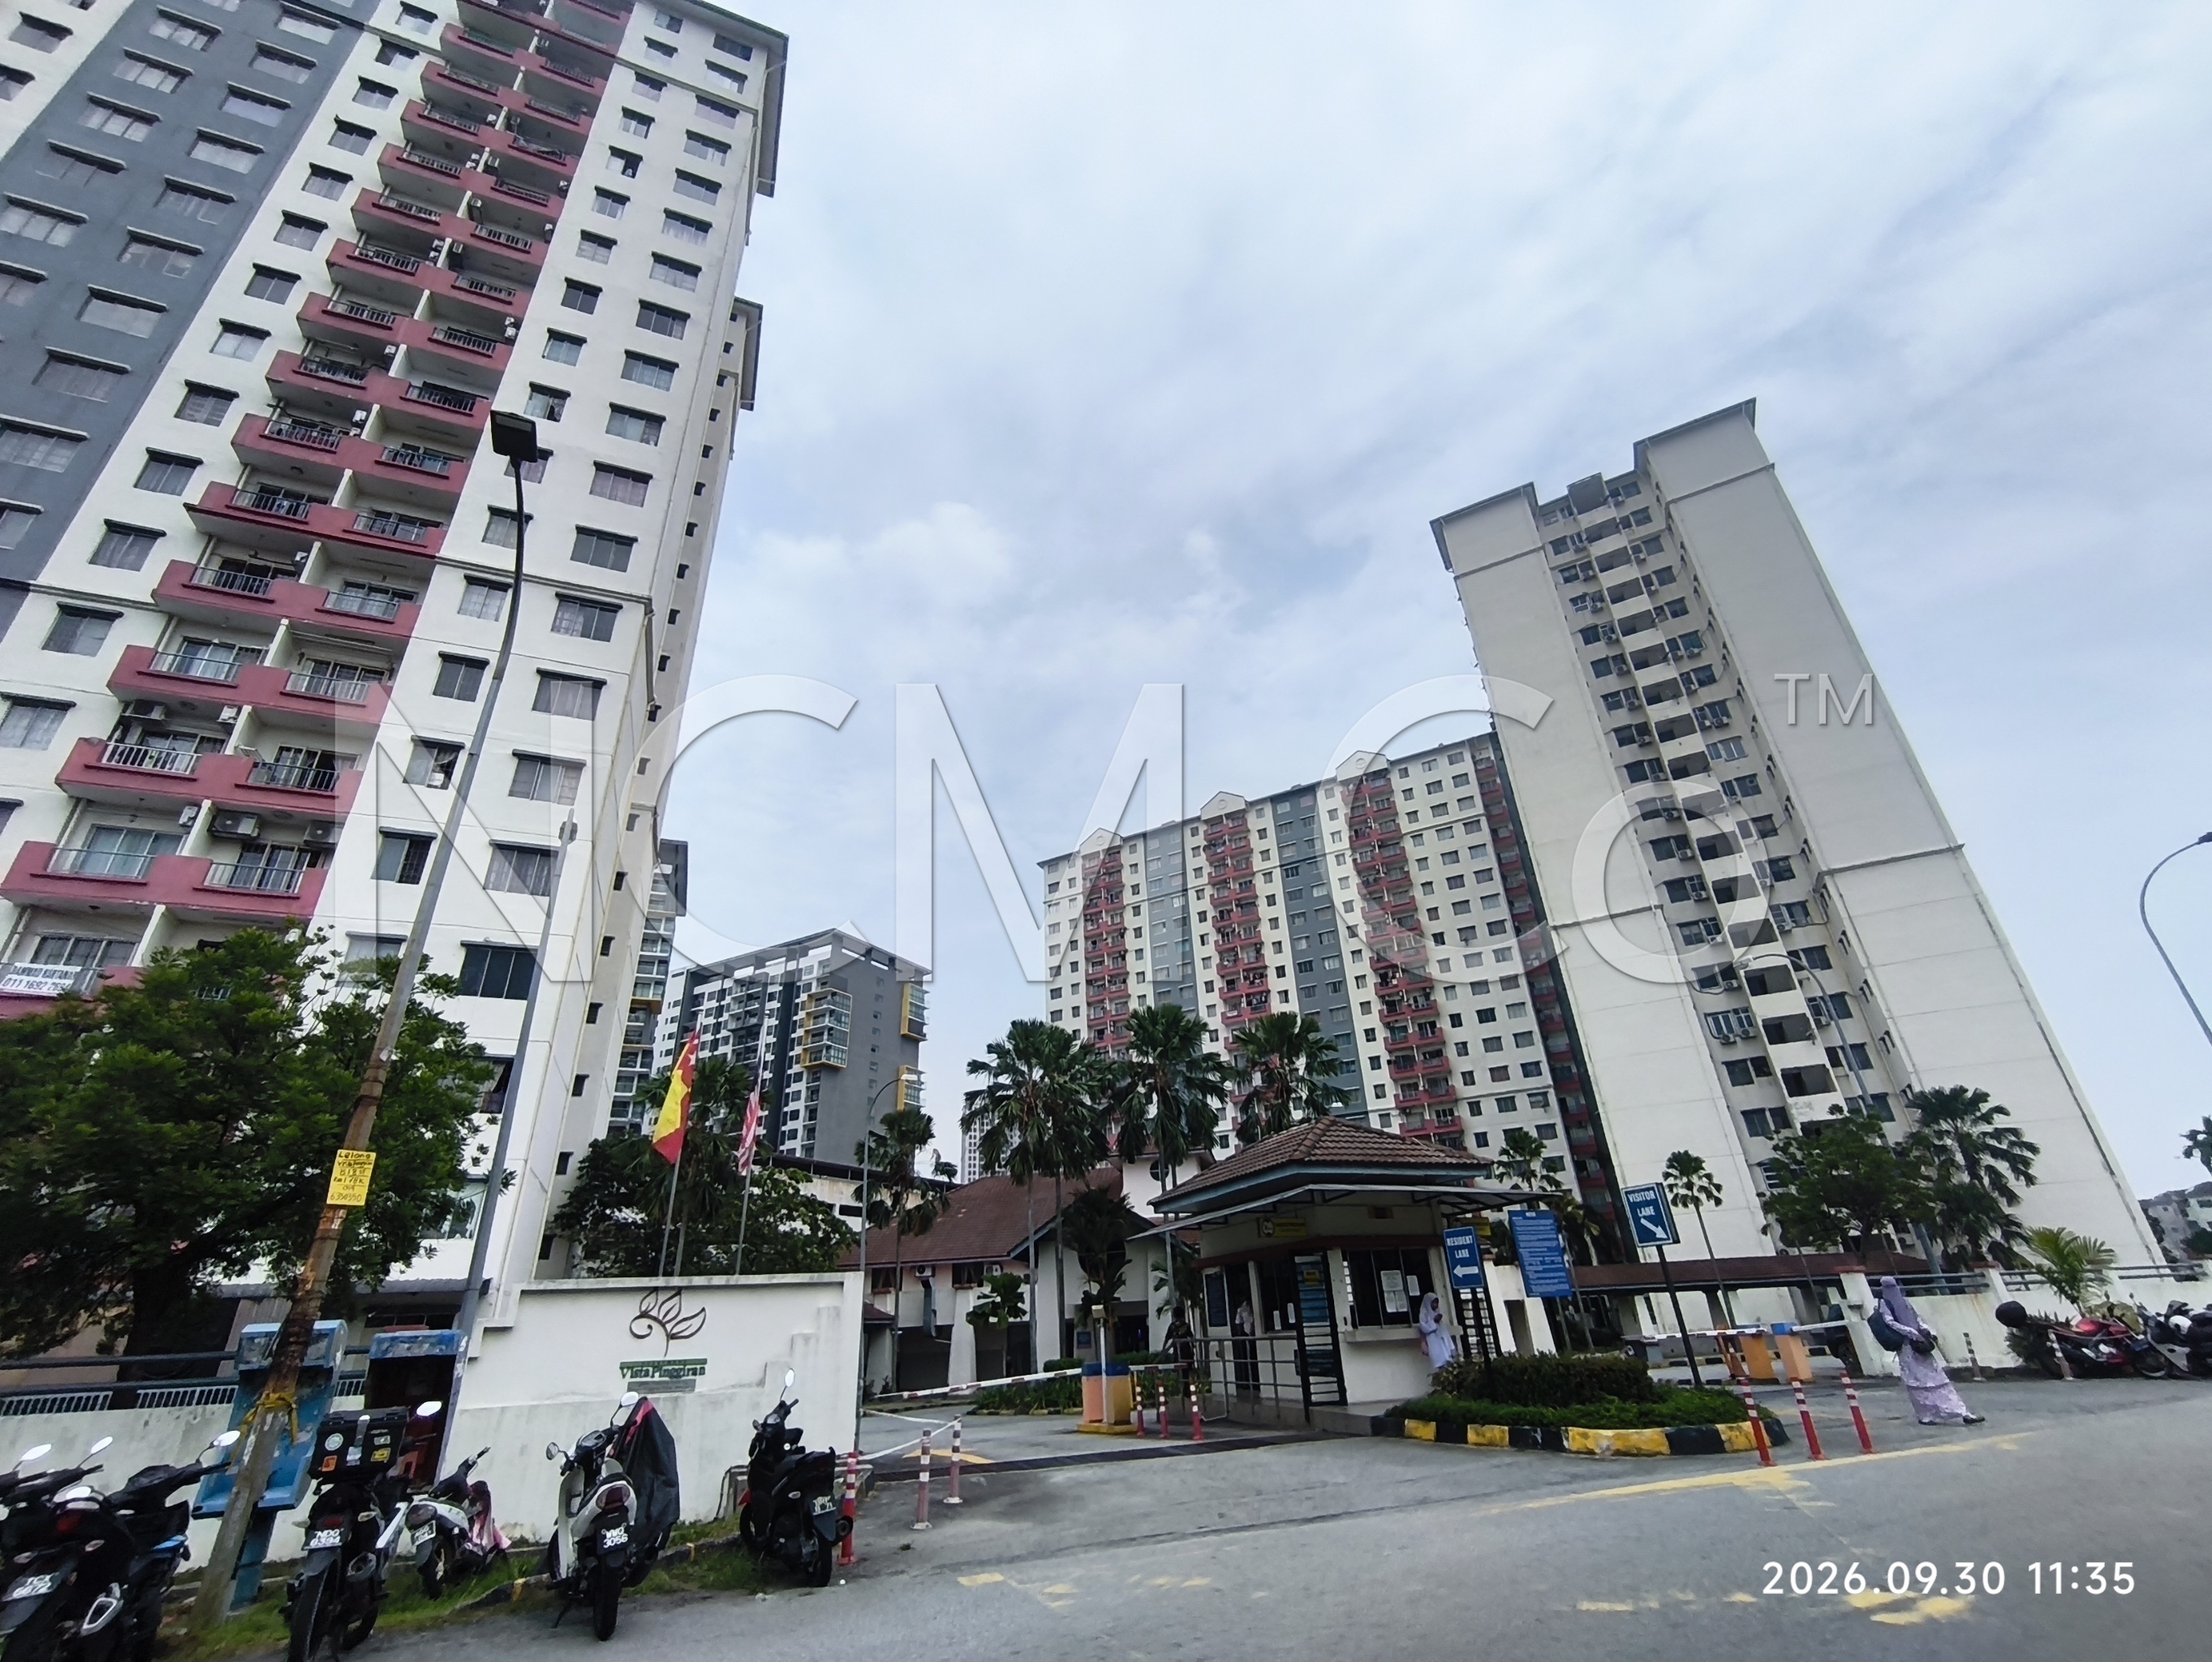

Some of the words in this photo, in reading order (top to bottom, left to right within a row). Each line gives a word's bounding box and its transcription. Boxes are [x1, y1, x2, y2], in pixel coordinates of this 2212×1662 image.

[1627, 1190, 1656, 1203] VISITOR
[1637, 1205, 1656, 1217] LANE
[1446, 1235, 1474, 1246] RESIDENT
[1454, 1248, 1470, 1259] LANE
[603, 1533, 629, 1548] 3056
